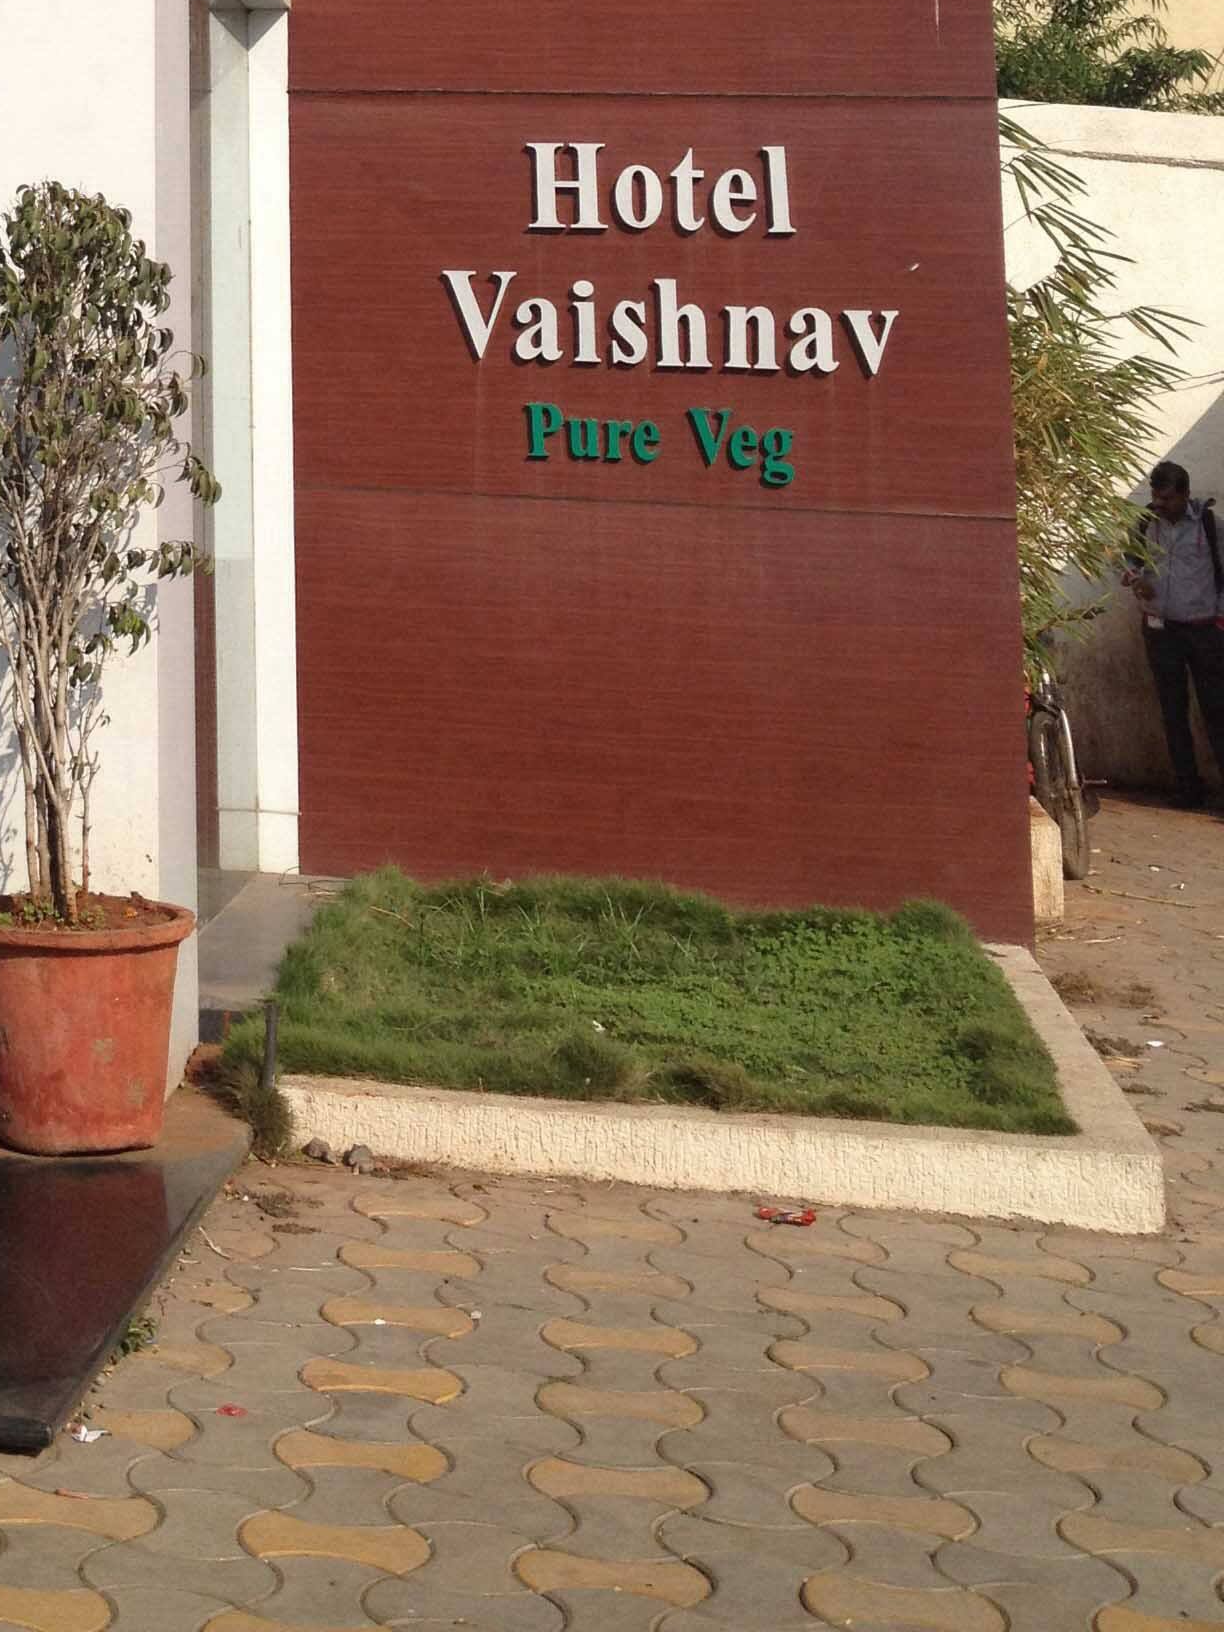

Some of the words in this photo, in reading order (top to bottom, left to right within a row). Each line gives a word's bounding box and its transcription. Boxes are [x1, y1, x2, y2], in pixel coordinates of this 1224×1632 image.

[526, 142, 796, 235] Hotel
[442, 270, 899, 376] Vaishnav
[525, 402, 661, 462] Pure
[688, 407, 795, 487] Veg
